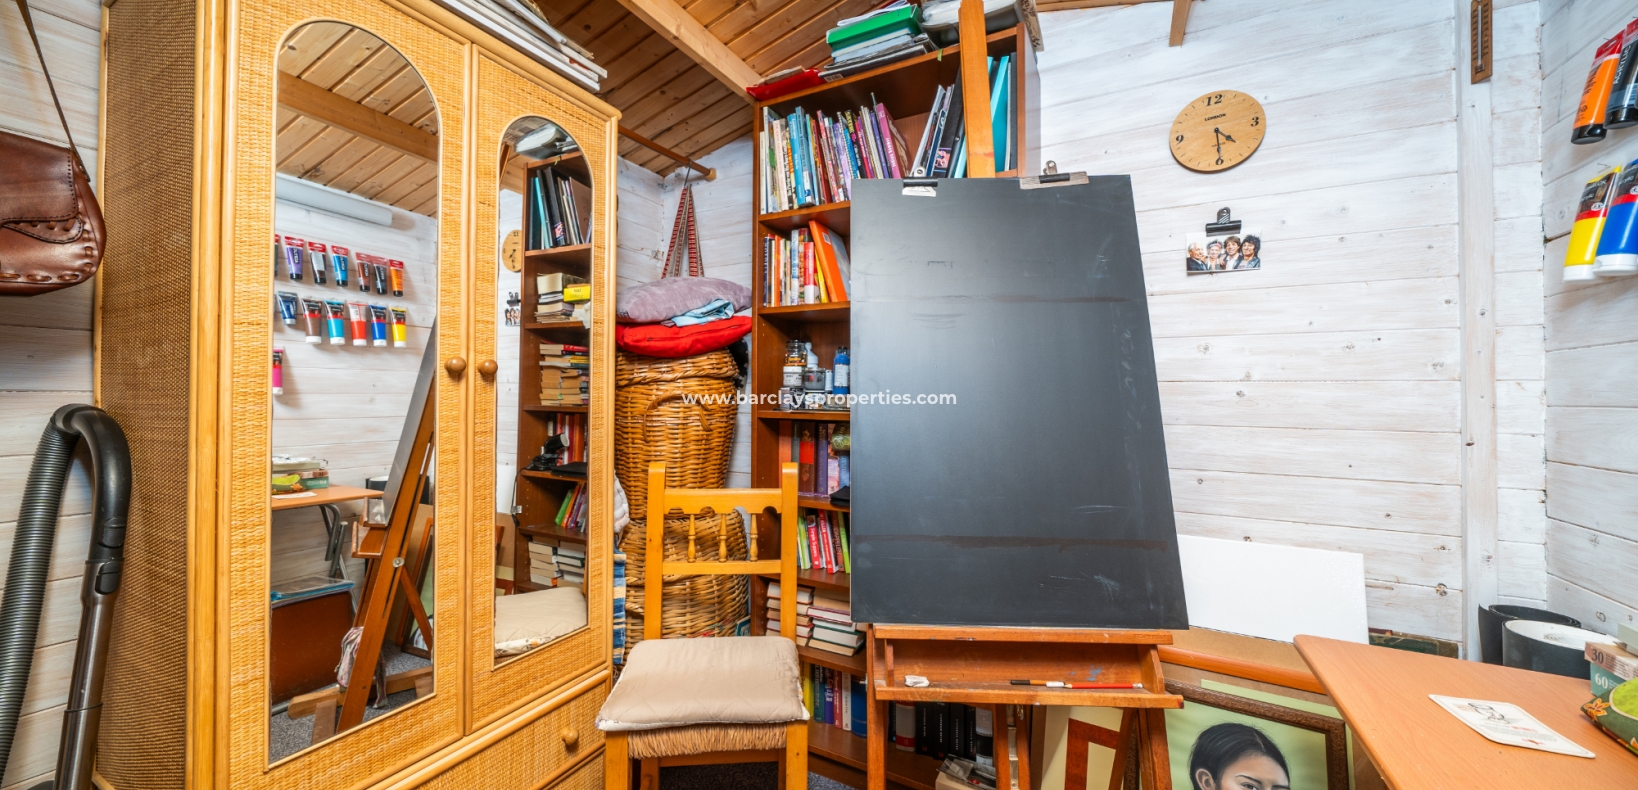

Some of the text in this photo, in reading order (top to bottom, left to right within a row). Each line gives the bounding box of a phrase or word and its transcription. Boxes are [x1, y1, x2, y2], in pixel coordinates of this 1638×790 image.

[1206, 94, 1222, 106] 12
[1204, 113, 1227, 121] LONDON
[1250, 117, 1259, 126] 3
[1176, 135, 1184, 145] 9
[1215, 156, 1224, 165] 6
[1591, 648, 1604, 664] 30
[1595, 673, 1608, 689] 60
